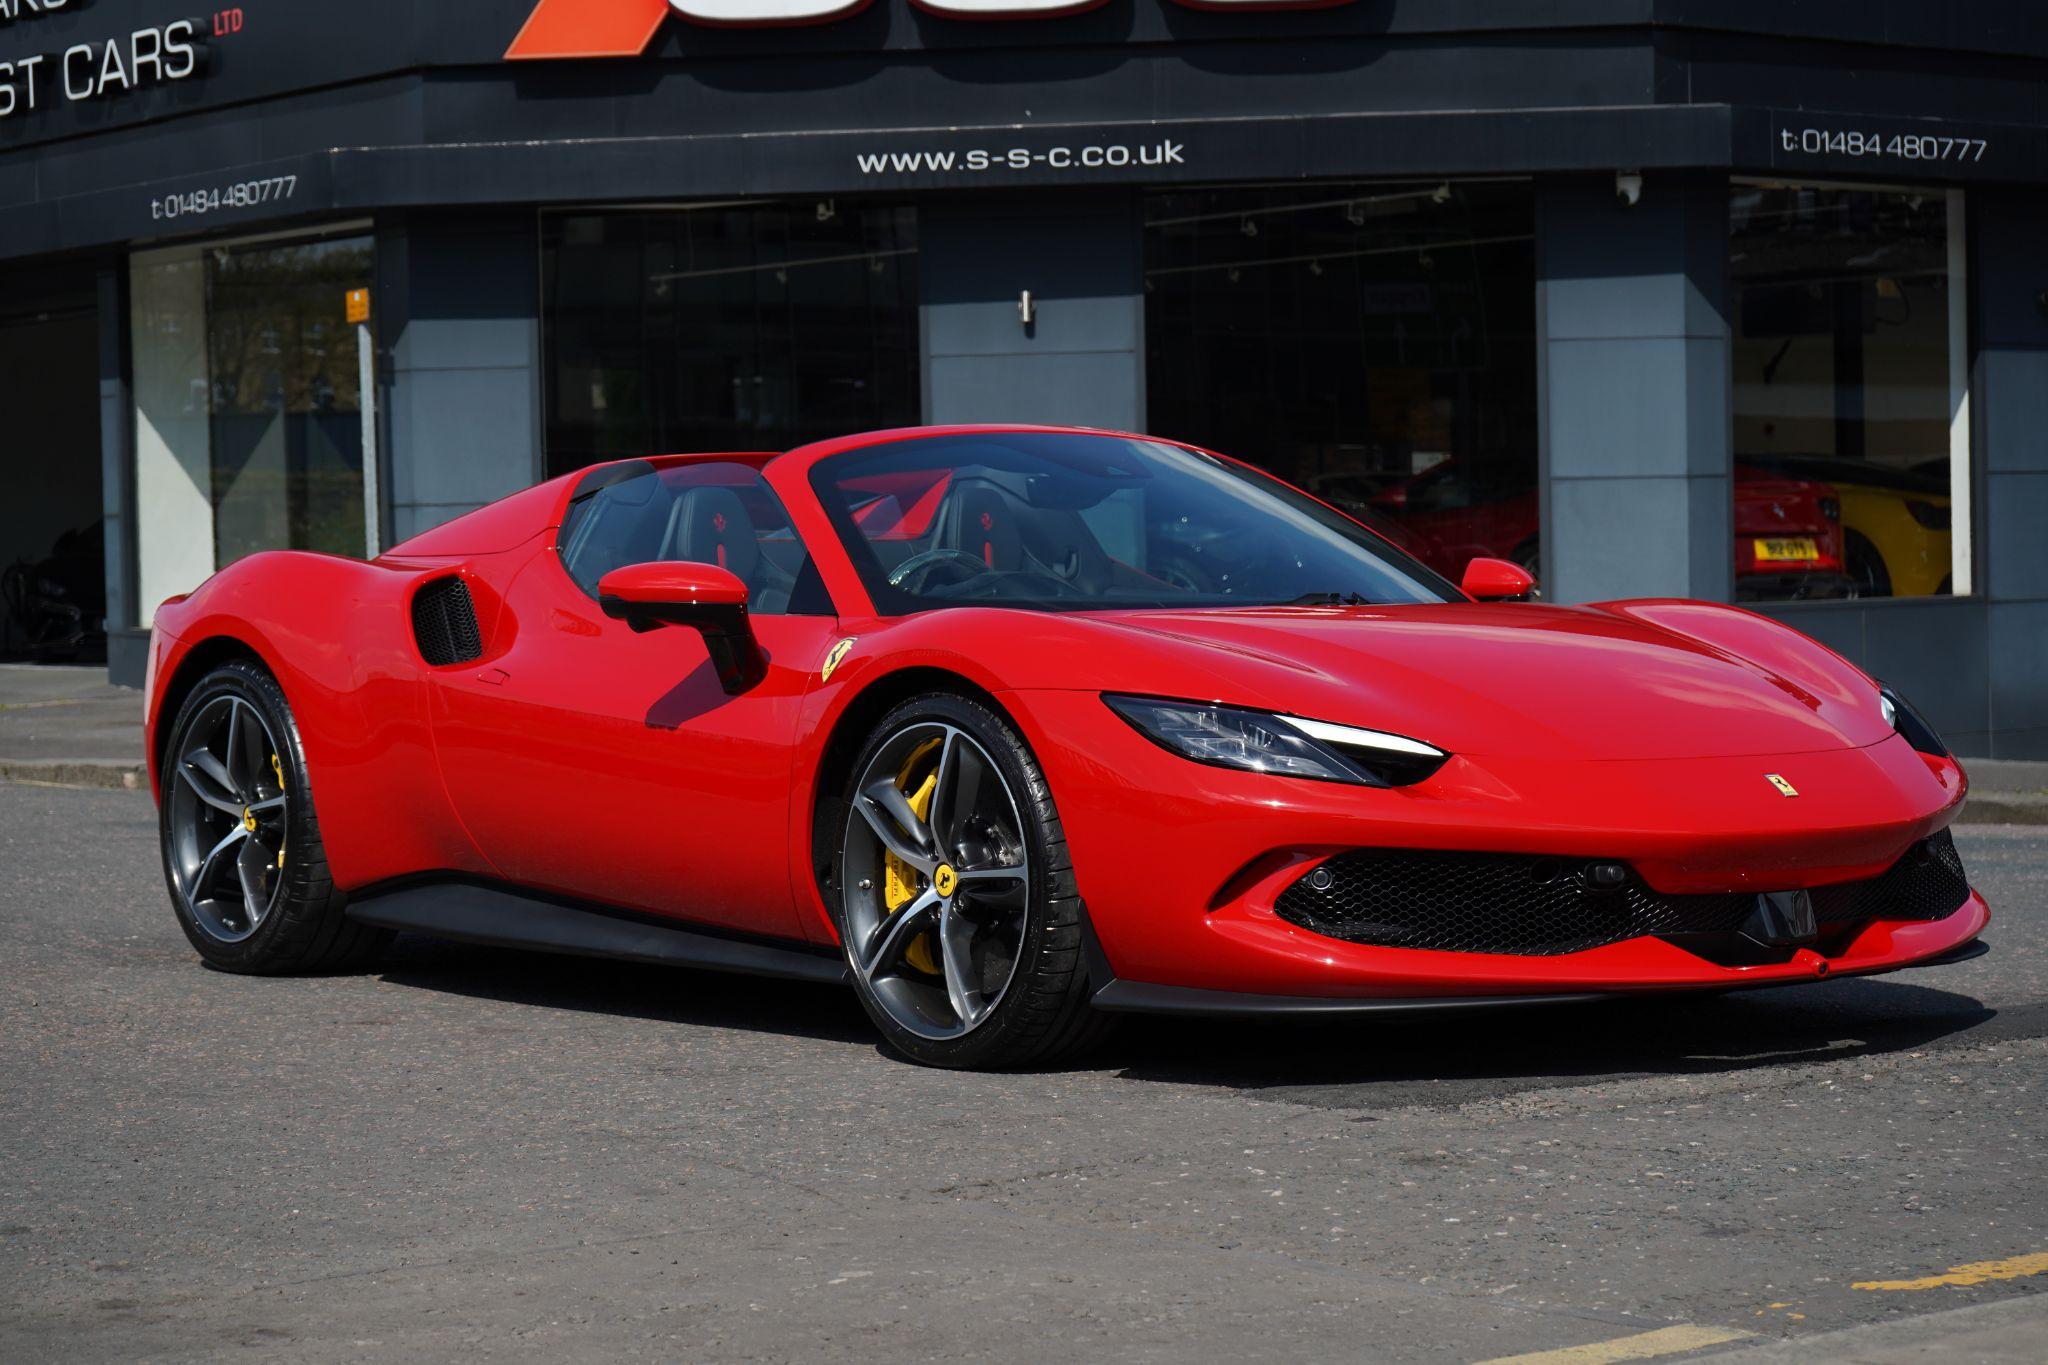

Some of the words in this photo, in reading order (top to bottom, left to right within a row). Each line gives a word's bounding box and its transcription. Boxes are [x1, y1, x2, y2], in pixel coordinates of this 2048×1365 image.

[63, 20, 194, 101] CARS
[213, 8, 243, 36] LTD
[857, 139, 1185, 174] www.s-s-c.co.uk
[1886, 135, 1987, 162] 480777
[221, 174, 298, 207] 480777
